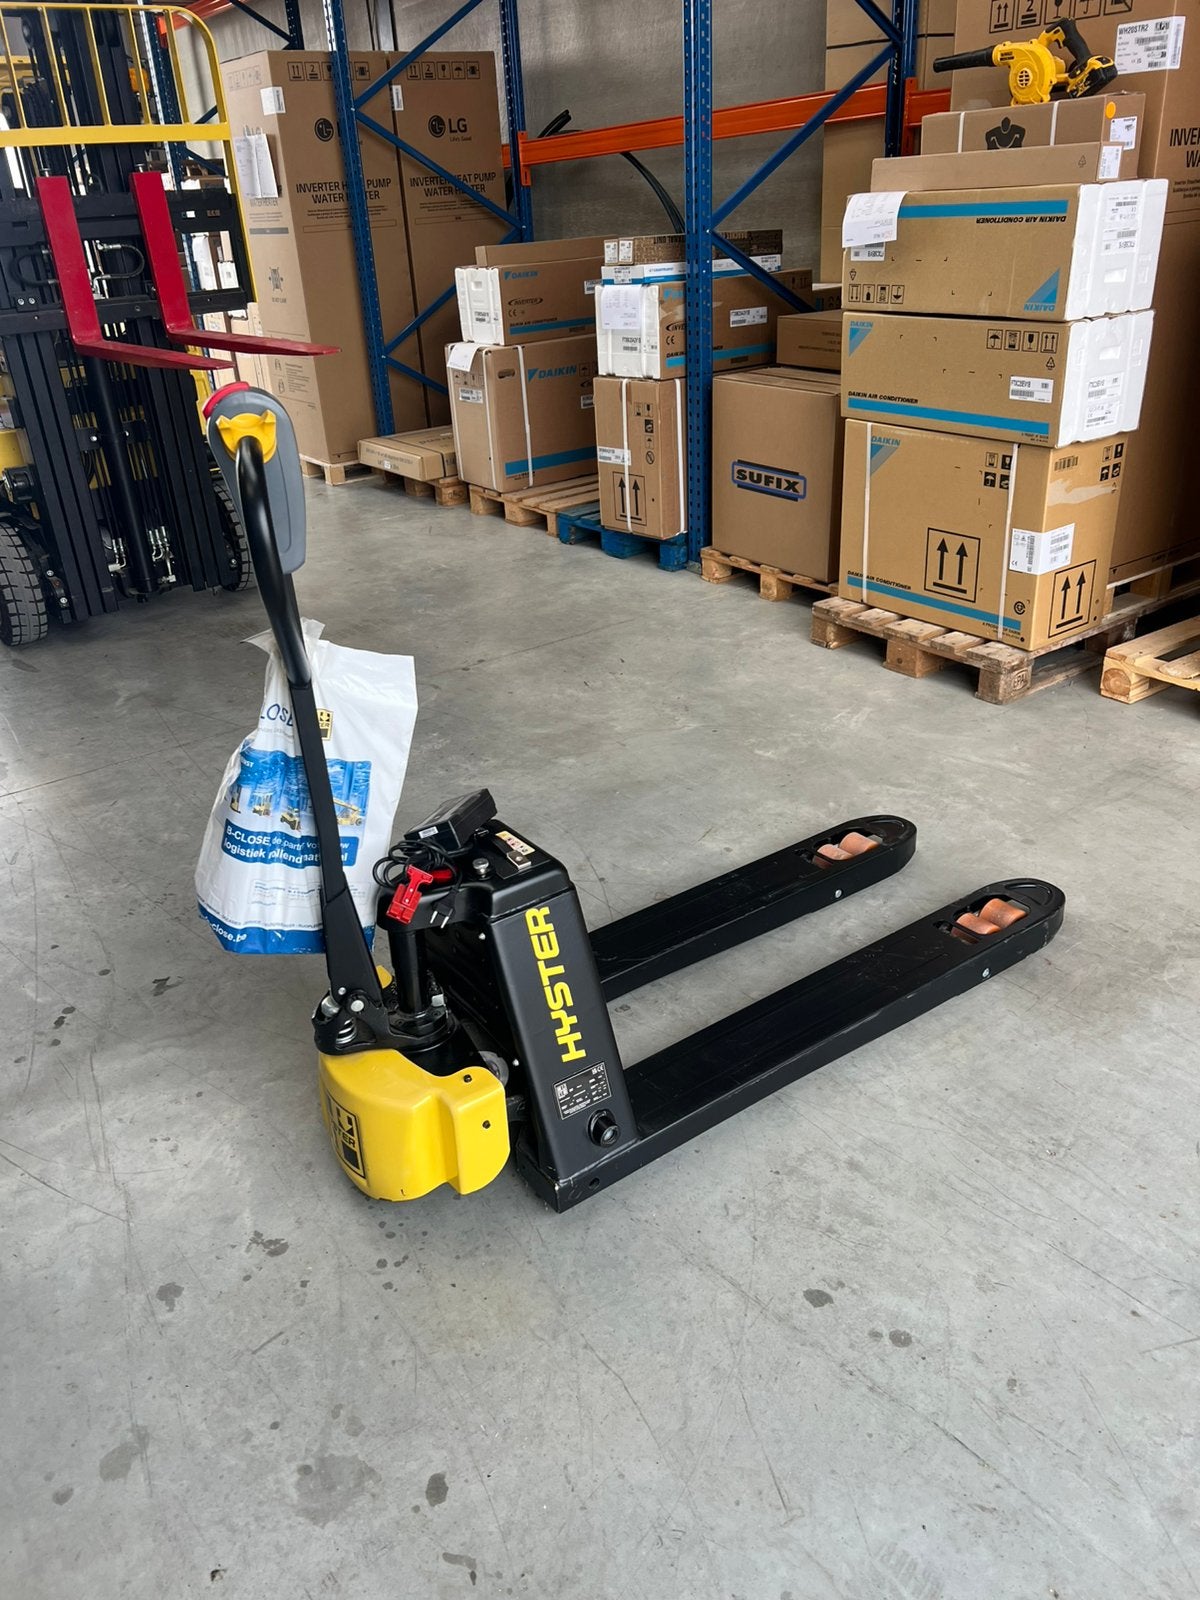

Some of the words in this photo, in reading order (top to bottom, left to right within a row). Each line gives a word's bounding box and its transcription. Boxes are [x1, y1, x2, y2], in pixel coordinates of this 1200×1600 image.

[448, 118, 467, 133] LG
[473, 172, 496, 182] PUMP
[296, 181, 340, 193] INVERTER
[366, 178, 392, 189] PUMP
[424, 186, 454, 197] WATER
[312, 192, 345, 204] WATER
[511, 271, 538, 279] DAIKIN
[1023, 303, 1055, 312] DAIKIN
[538, 365, 577, 379] DAIKIN
[879, 394, 918, 404] CONDITIONER
[871, 436, 900, 446] DAIKIN
[736, 468, 800, 493] SUFIX
[223, 837, 267, 859] logistiek
[525, 906, 587, 1063] HYSTER
